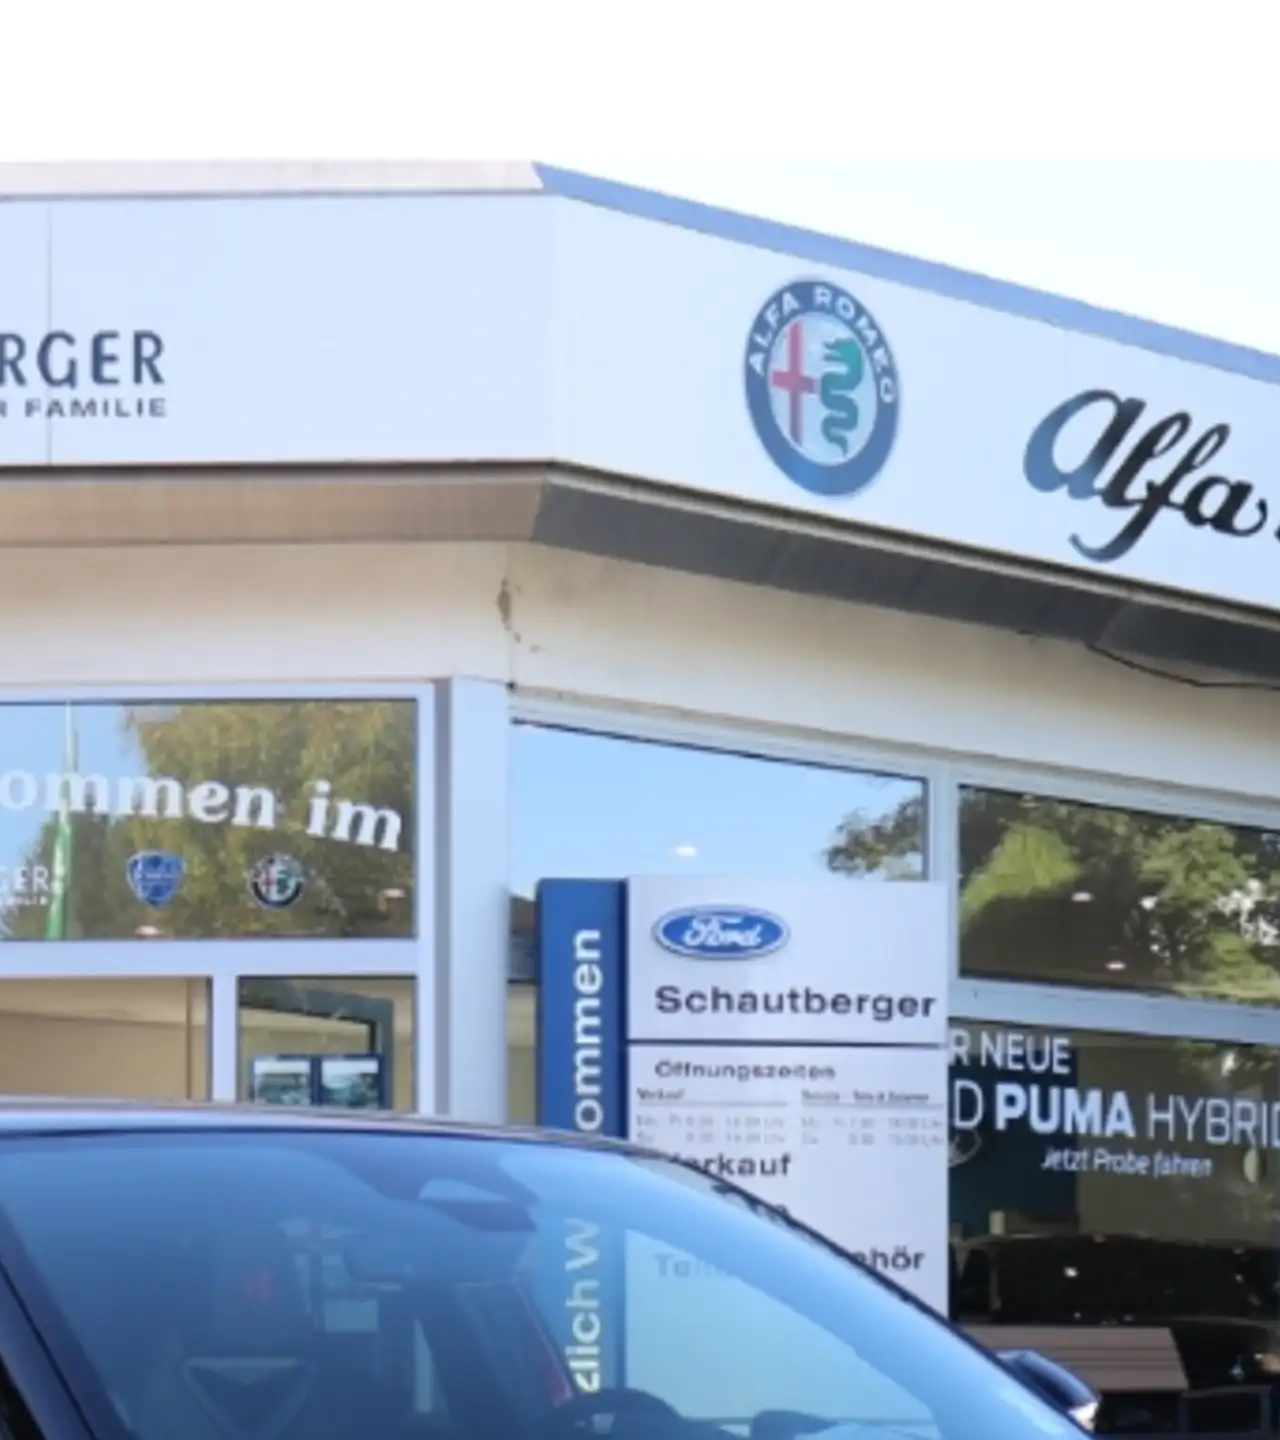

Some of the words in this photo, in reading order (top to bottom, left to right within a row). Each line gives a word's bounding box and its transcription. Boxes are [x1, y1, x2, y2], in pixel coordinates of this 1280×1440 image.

[749, 290, 801, 377] ALFA
[813, 285, 896, 403] ROMEO
[25, 397, 167, 418] FAMILIE
[1022, 389, 1267, 562] Alfa
[306, 779, 402, 850] im
[654, 985, 938, 1022] Schautberger
[981, 1032, 1071, 1075] NEUE
[994, 1082, 1137, 1139] PUMA
[1093, 1150, 1149, 1174] Probe
[1152, 1153, 1213, 1178] fahren
